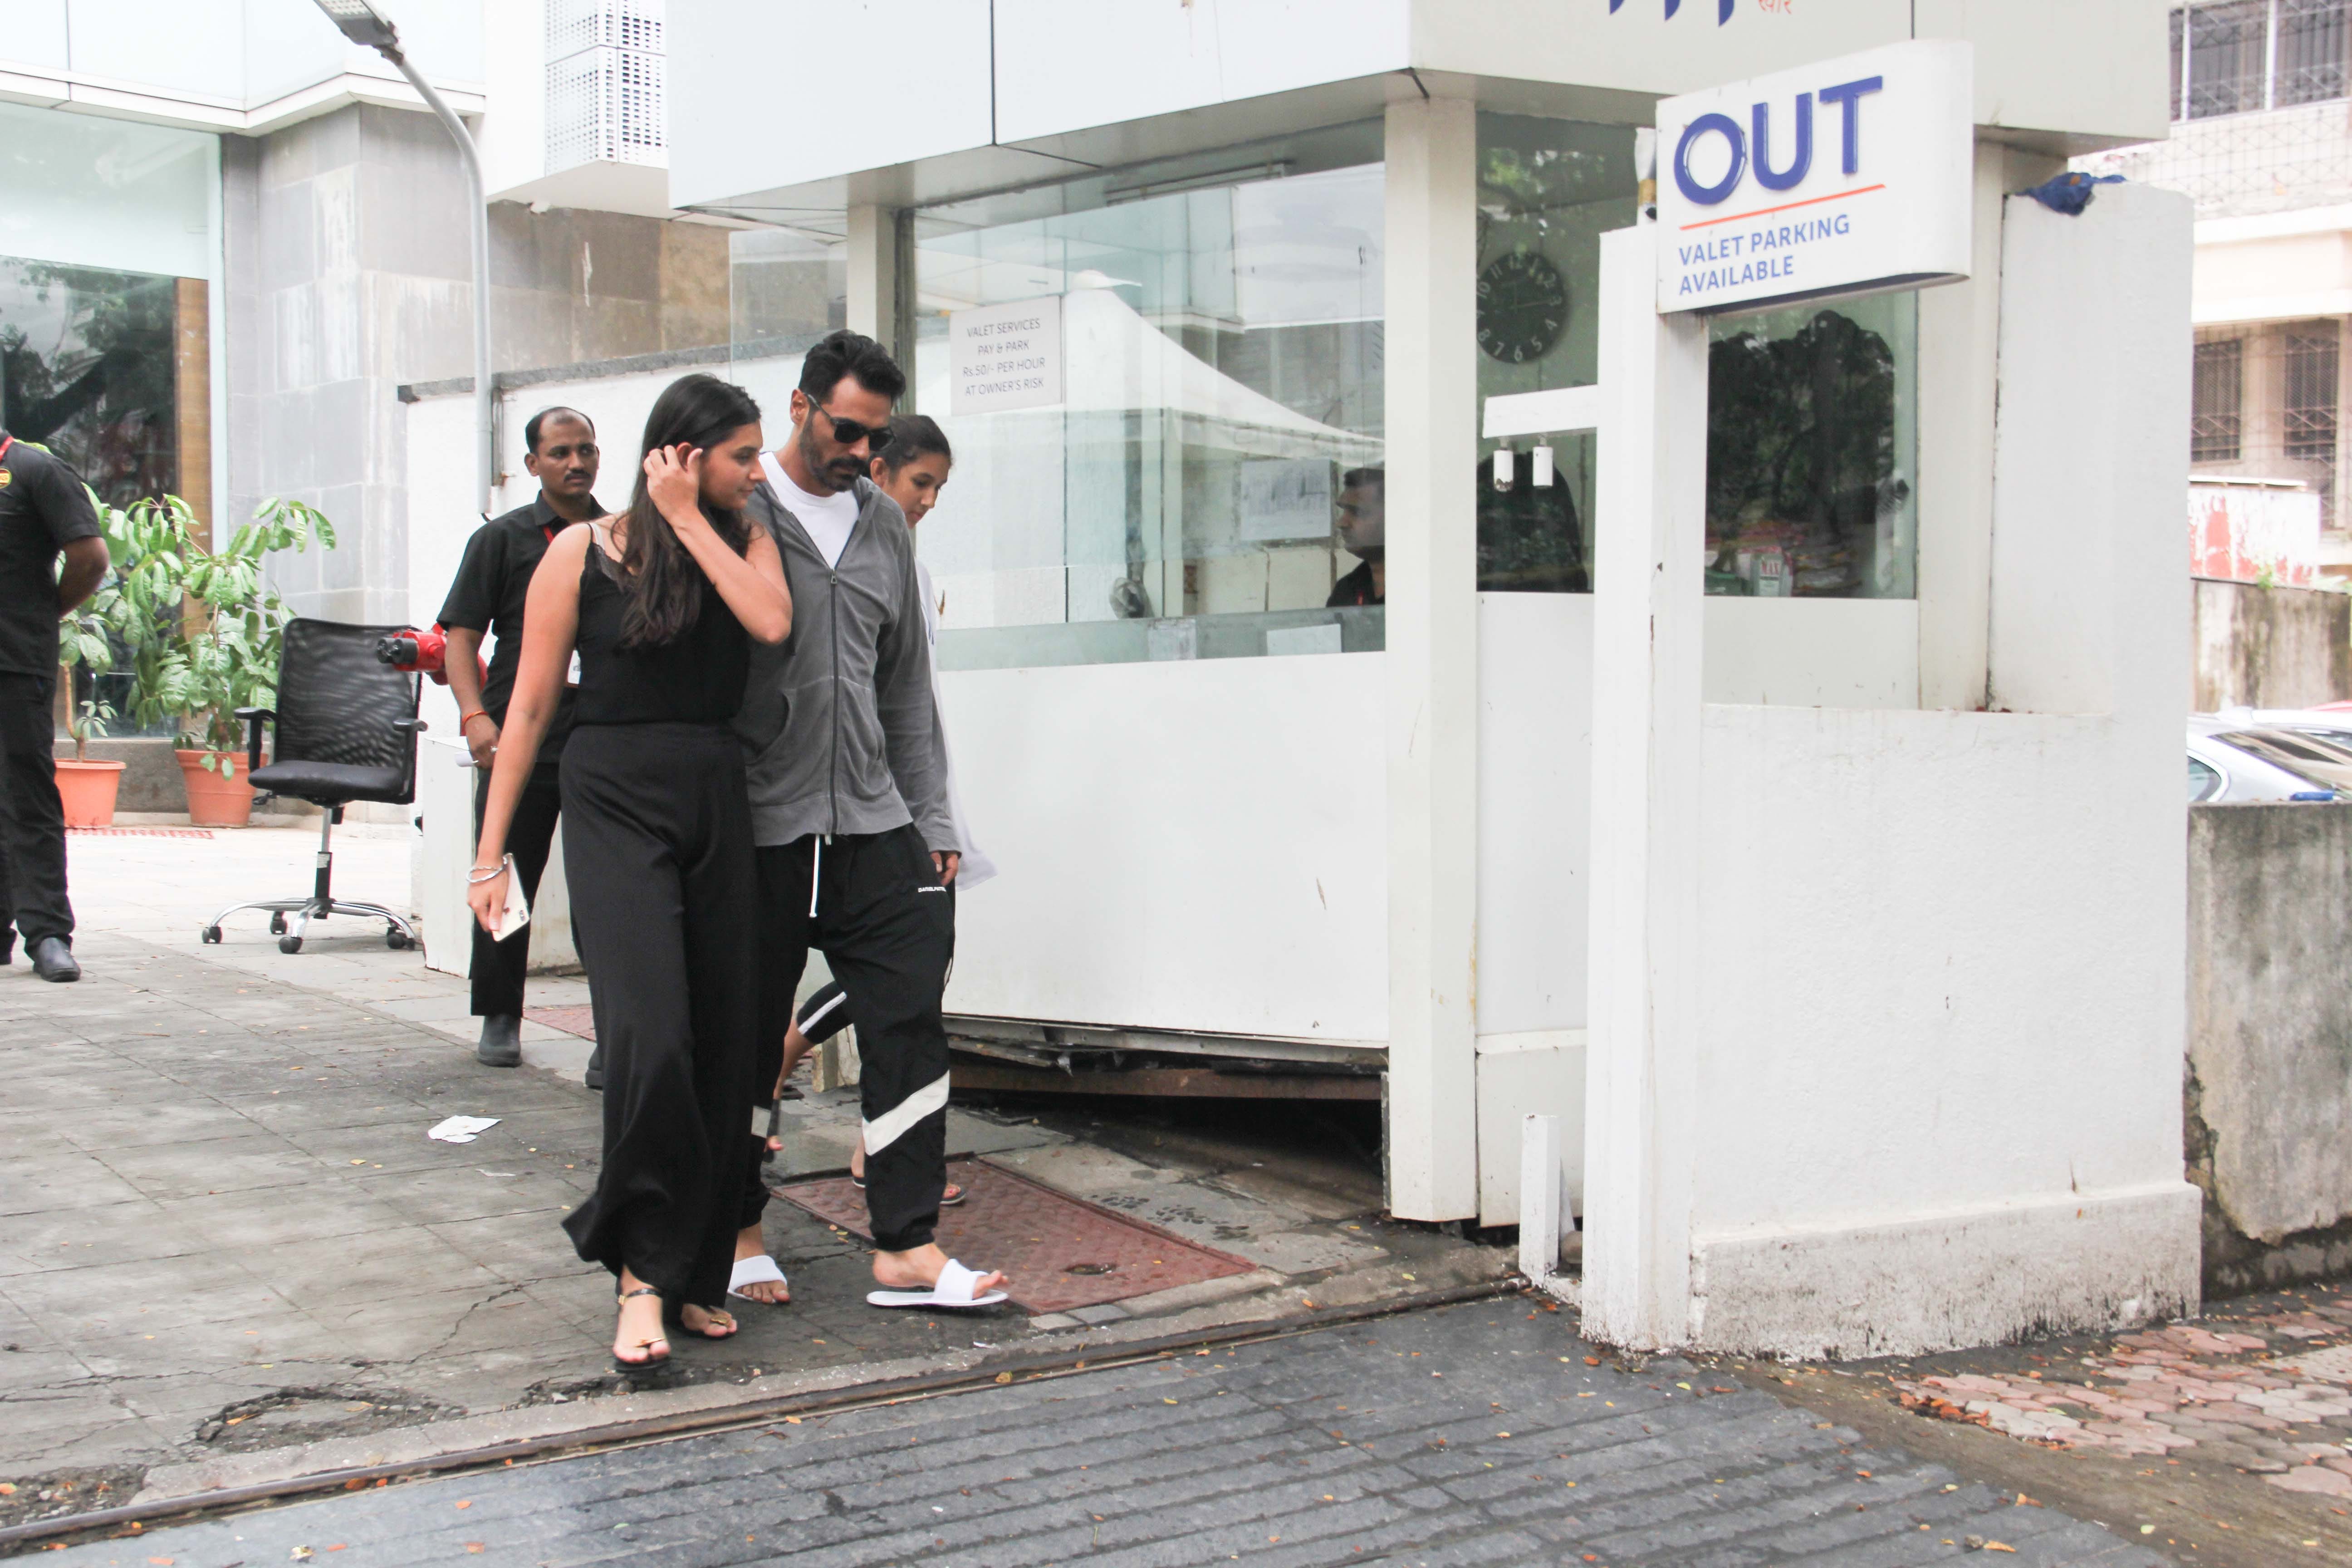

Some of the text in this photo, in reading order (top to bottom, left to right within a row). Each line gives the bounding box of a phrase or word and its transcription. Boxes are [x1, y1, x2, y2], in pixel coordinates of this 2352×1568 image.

[1674, 75, 1883, 205] OUT
[1679, 214, 1850, 266] VALET PARKING
[1679, 255, 1793, 296] AVAILABLE
[967, 318, 1040, 338] VALET SERVICES
[978, 340, 1029, 356] PAY & PARK
[962, 357, 1045, 377] Rs.50/- PER HOUR
[965, 377, 1044, 396] AT OWNER'S RISK
